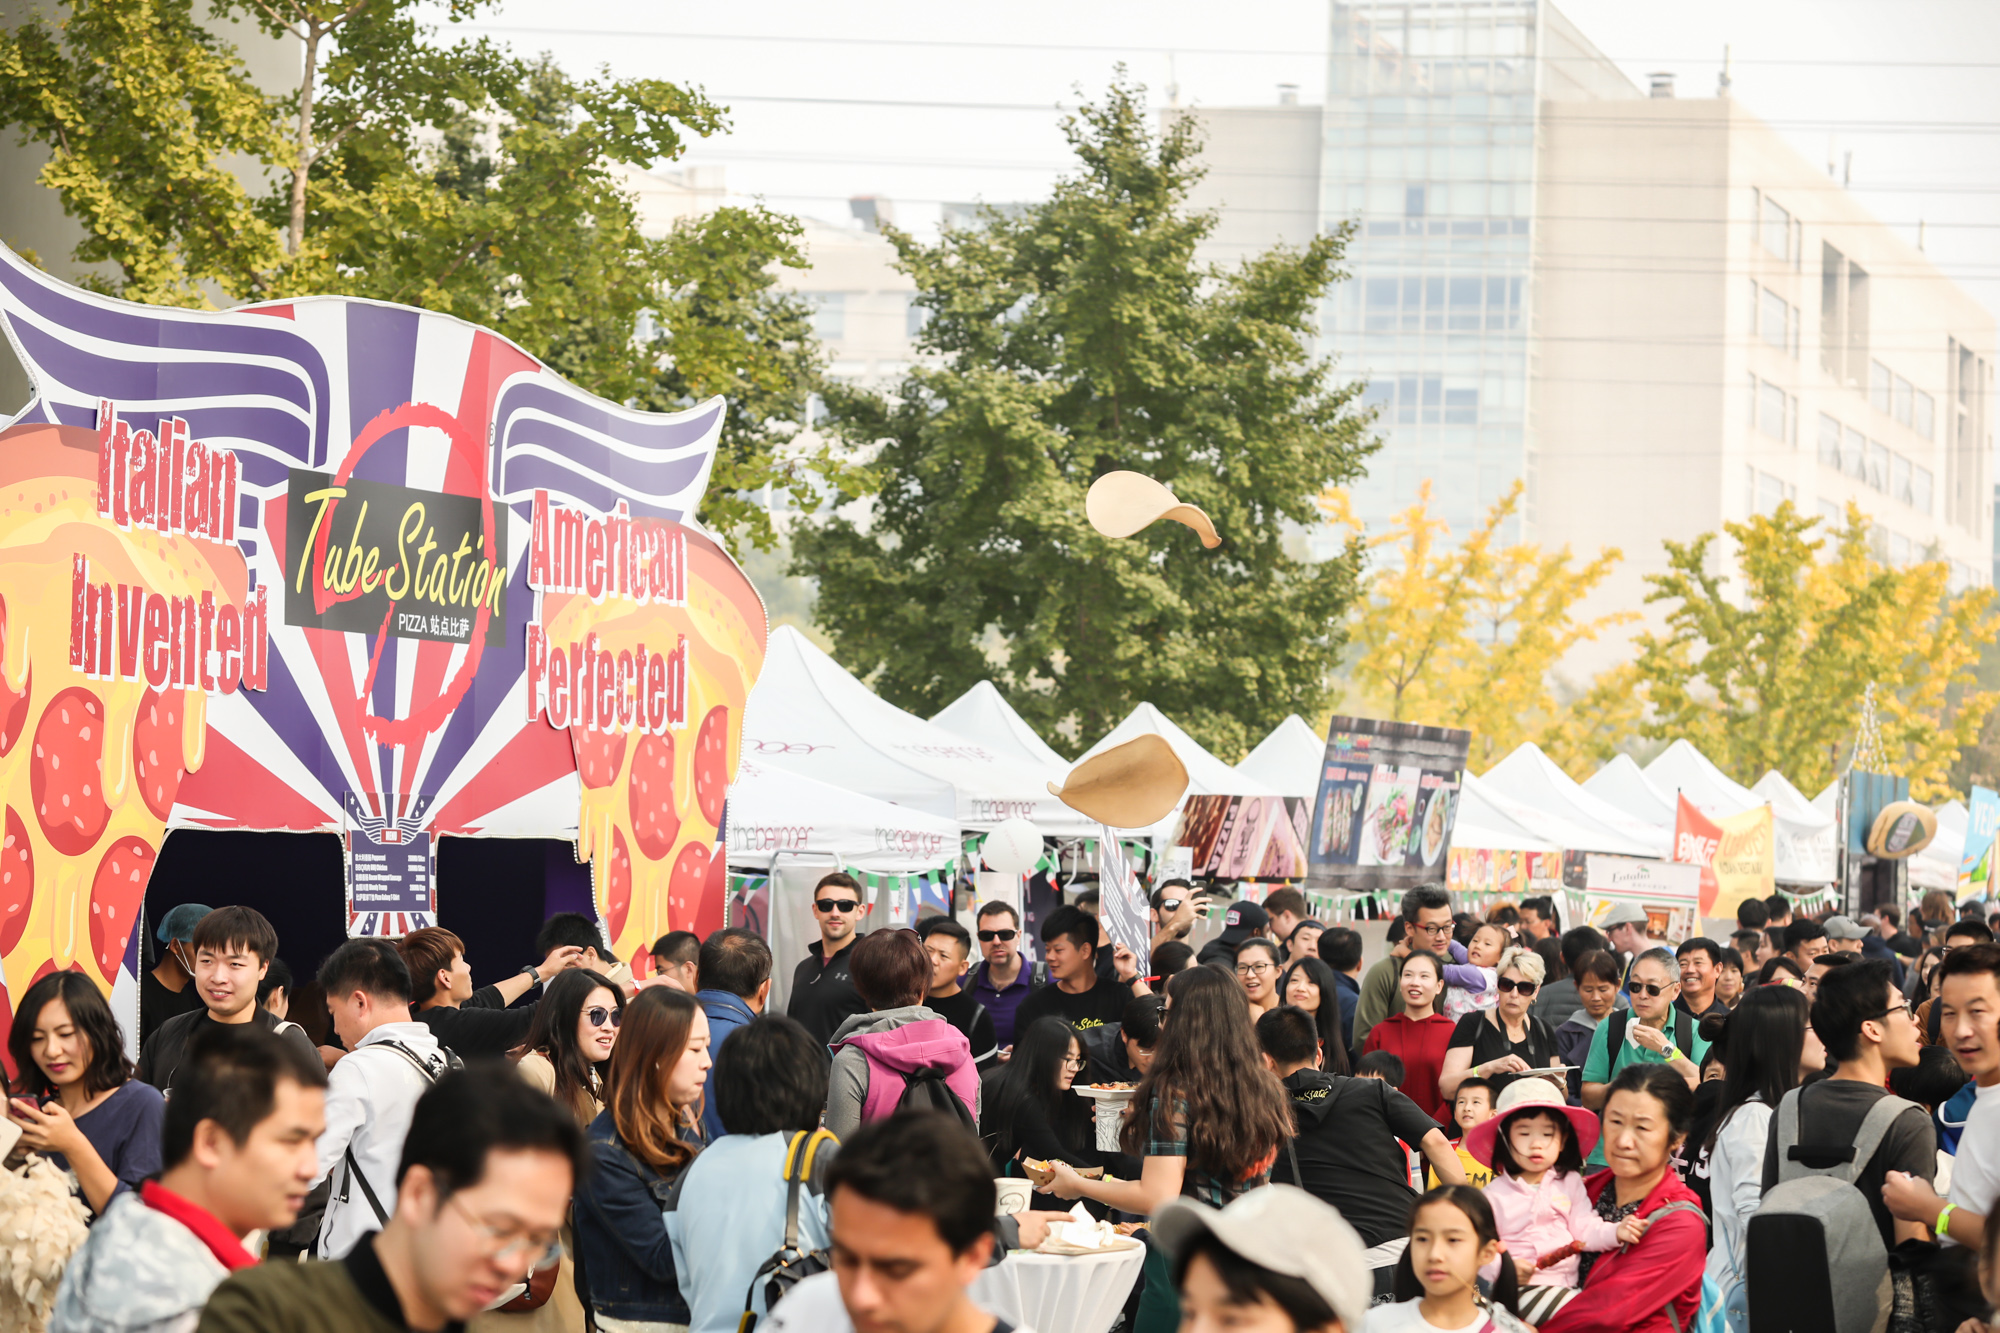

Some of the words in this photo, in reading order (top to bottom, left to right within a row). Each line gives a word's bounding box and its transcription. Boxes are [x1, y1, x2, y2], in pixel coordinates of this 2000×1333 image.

[97, 400, 238, 541] Italian
[296, 487, 383, 594] Tube
[385, 501, 507, 617] Station
[530, 489, 686, 602] American
[69, 552, 268, 695] Invented
[399, 613, 428, 633] PIZZA
[430, 615, 470, 638] 站点比萨
[527, 624, 686, 731] Perfected
[1207, 804, 1240, 872] PIZZA
